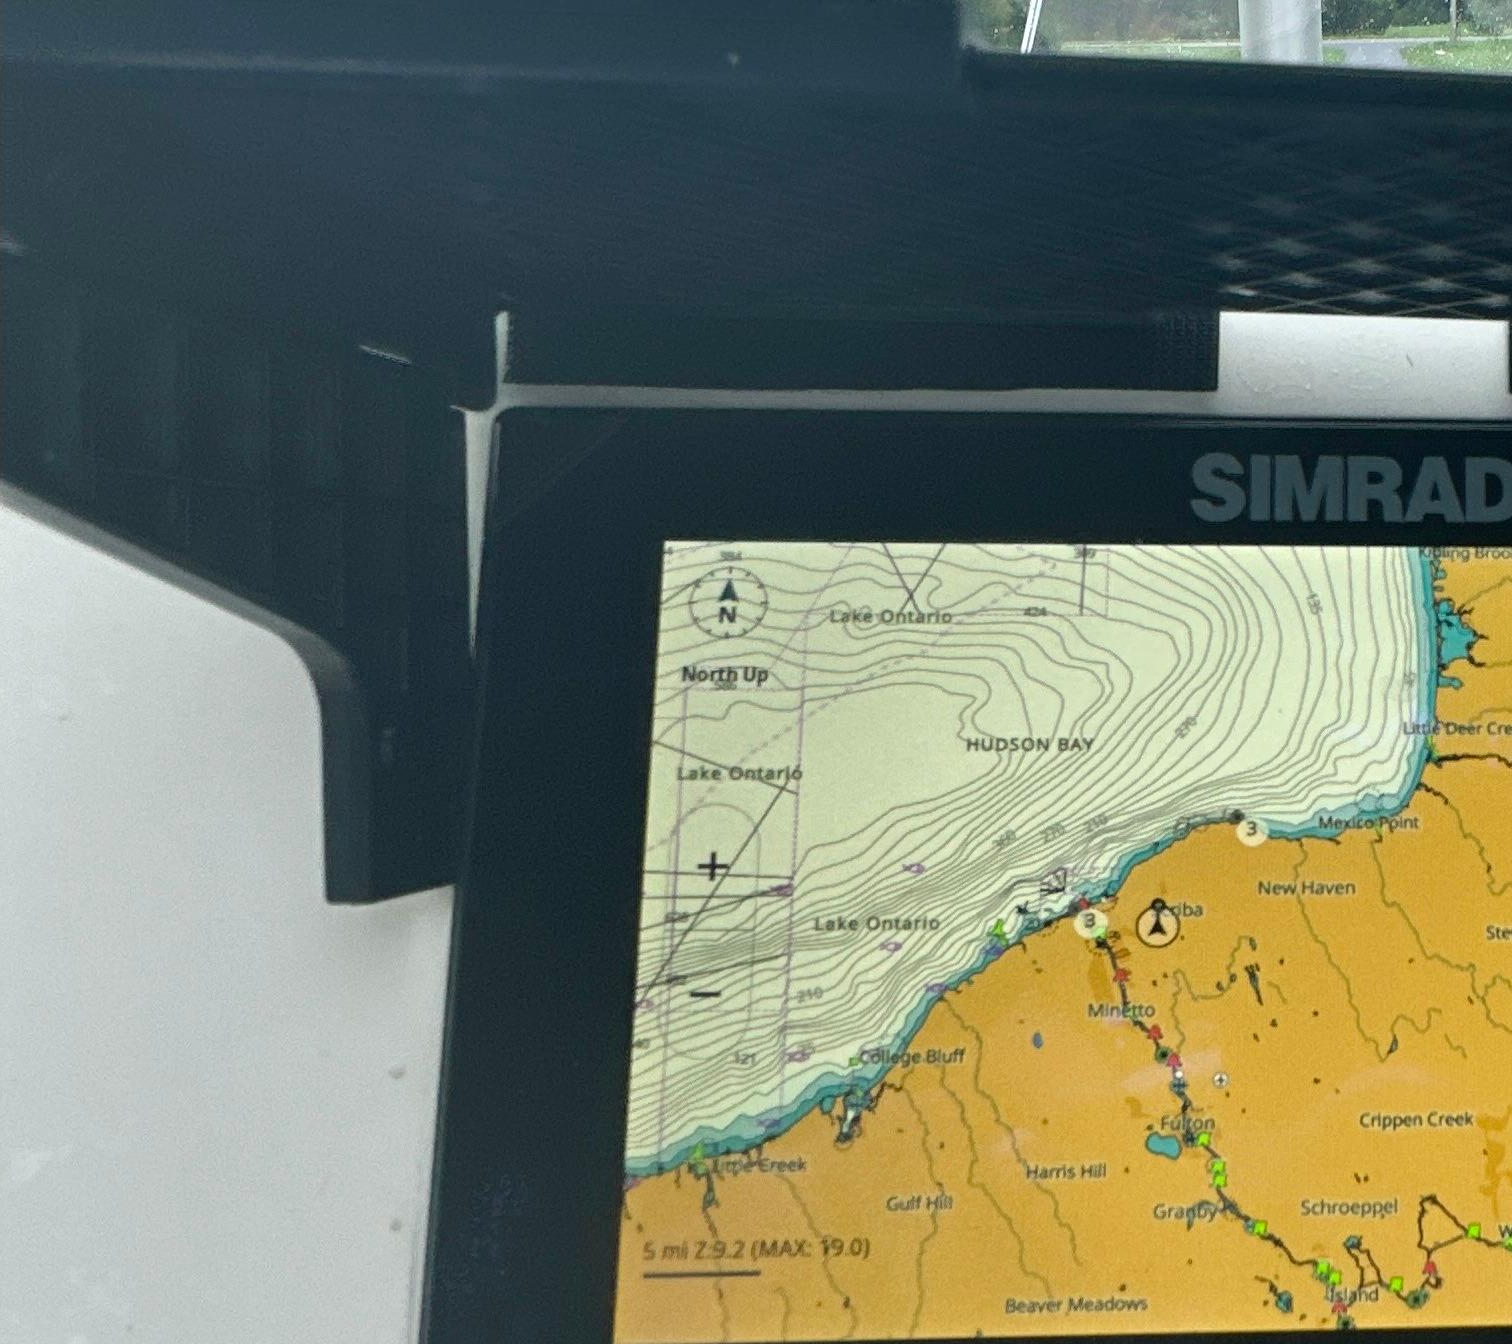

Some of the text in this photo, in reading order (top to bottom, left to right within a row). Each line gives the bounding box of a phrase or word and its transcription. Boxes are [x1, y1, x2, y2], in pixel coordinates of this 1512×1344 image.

[718, 607, 737, 624] N
[830, 609, 953, 625] Lake Ontario
[682, 665, 769, 687] North Up
[1403, 720, 1440, 736] Little
[1445, 721, 1482, 736] Deer
[966, 737, 1093, 752] HUDSON BAY
[677, 766, 803, 782] Lake Ontario
[1246, 821, 1257, 837] 3
[1318, 814, 1419, 831] Mexico Point
[1257, 878, 1356, 897] New Haven
[814, 915, 940, 932] Lake Ontario
[1083, 912, 1096, 928] 3
[1088, 1002, 1156, 1019] Minetto
[859, 1047, 965, 1067] College Bluff
[1161, 1114, 1216, 1131] Fulton
[1360, 1110, 1474, 1131] Crippen Creek
[1026, 1163, 1107, 1180] Harris Hill
[925, 1194, 953, 1211] Hill
[1301, 1198, 1399, 1218] Schroeppel
[1153, 1202, 1218, 1223] Granby
[820, 1236, 870, 1260] 19.0)
[1005, 1296, 1148, 1314] Beaver Meadows
